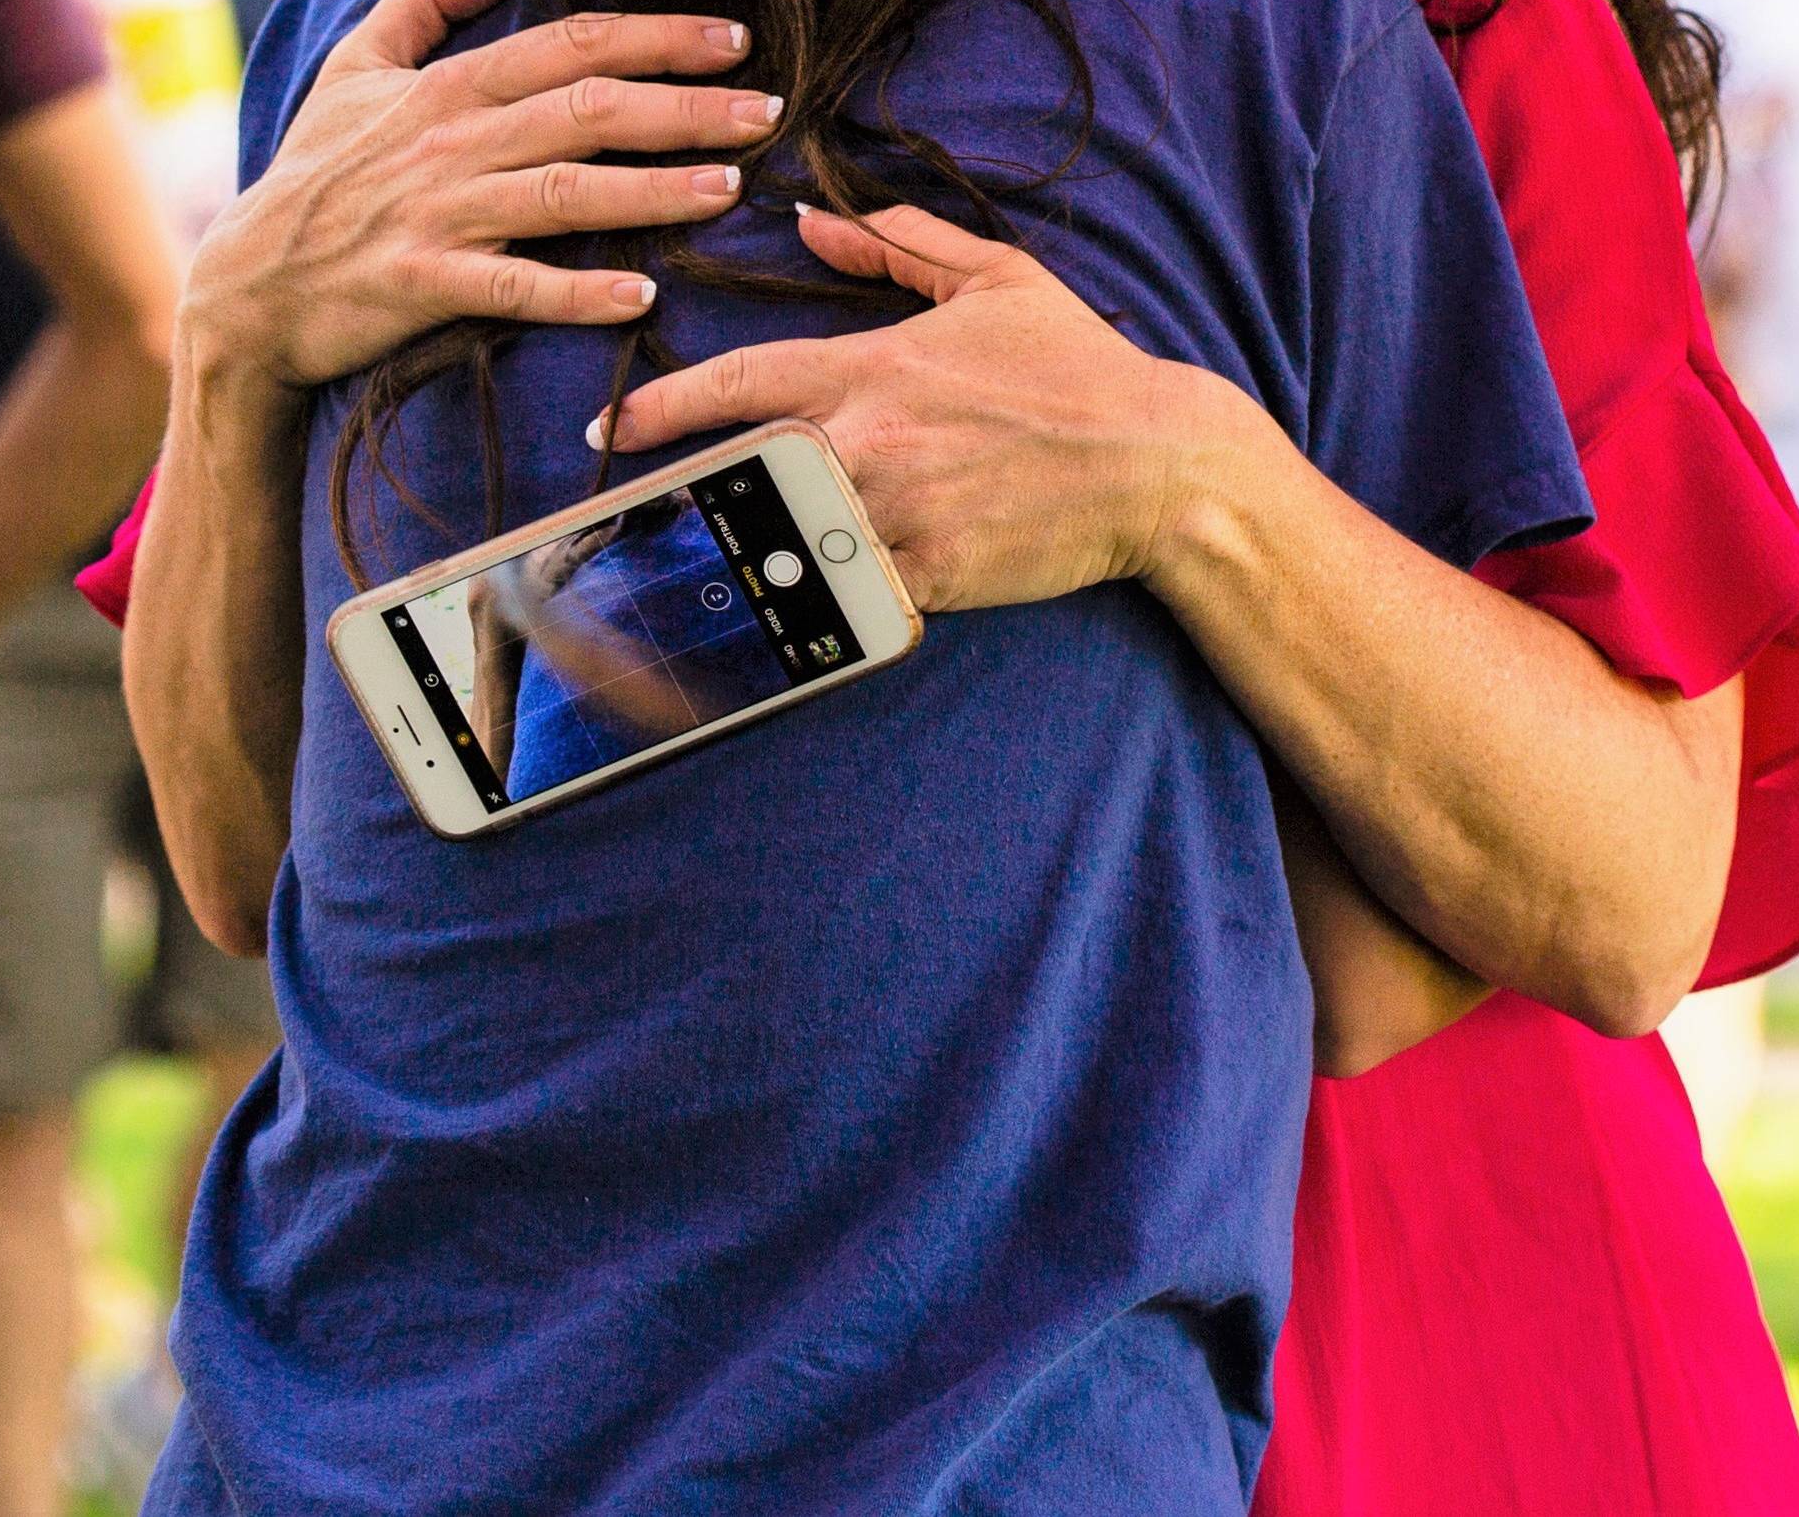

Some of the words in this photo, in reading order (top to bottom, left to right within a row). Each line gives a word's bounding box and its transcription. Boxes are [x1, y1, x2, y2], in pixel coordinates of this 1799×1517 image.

[712, 512, 742, 556] PORTRAIT
[742, 565, 765, 598] PHOTO
[764, 607, 784, 636] VIDEO
